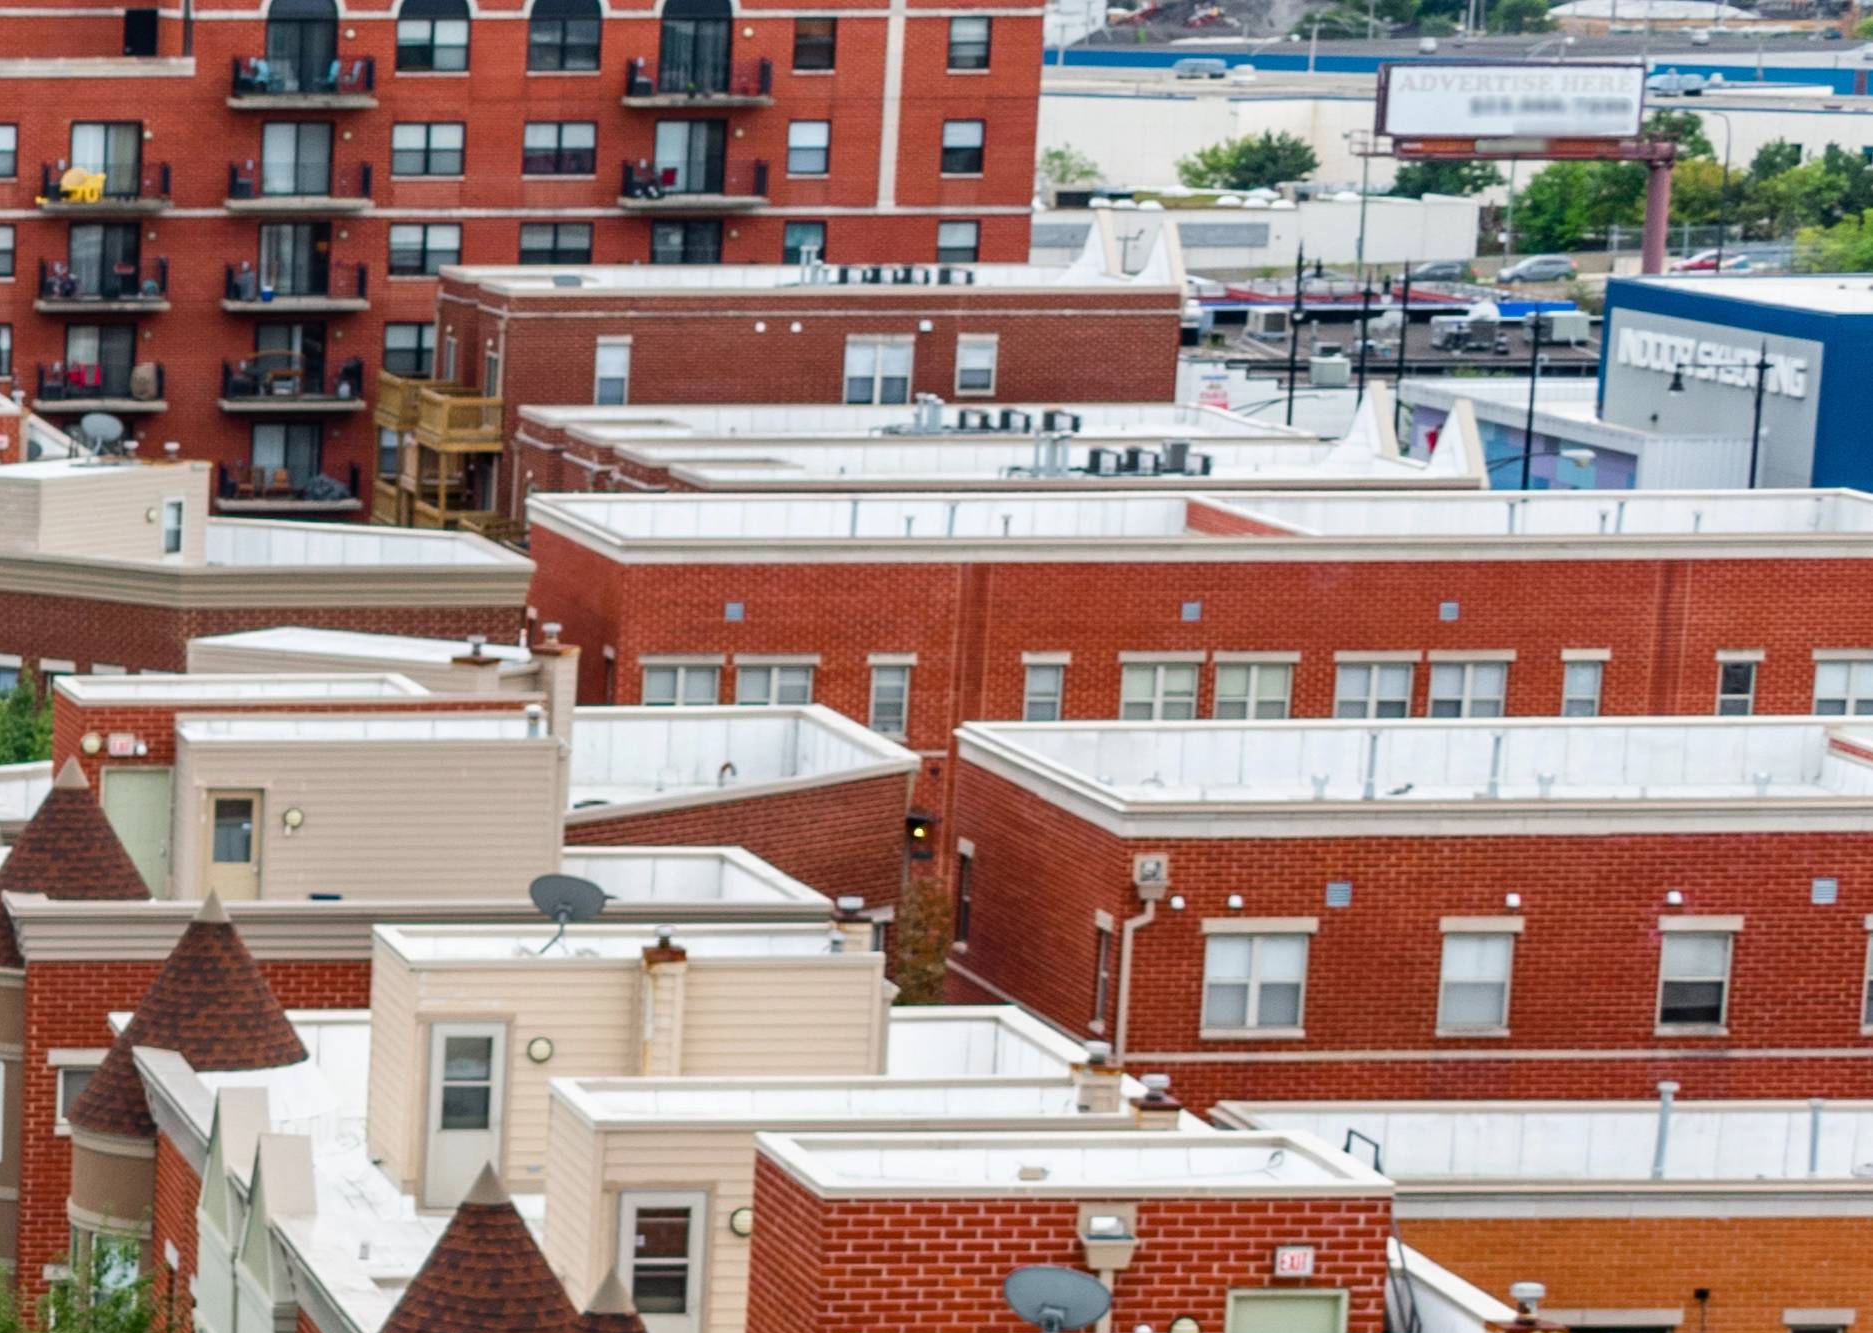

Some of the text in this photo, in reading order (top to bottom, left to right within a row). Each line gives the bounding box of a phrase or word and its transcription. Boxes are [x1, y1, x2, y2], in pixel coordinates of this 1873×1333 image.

[1399, 73, 1633, 93] ADVERTISE HERE
[1617, 327, 1697, 377] INDOOR
